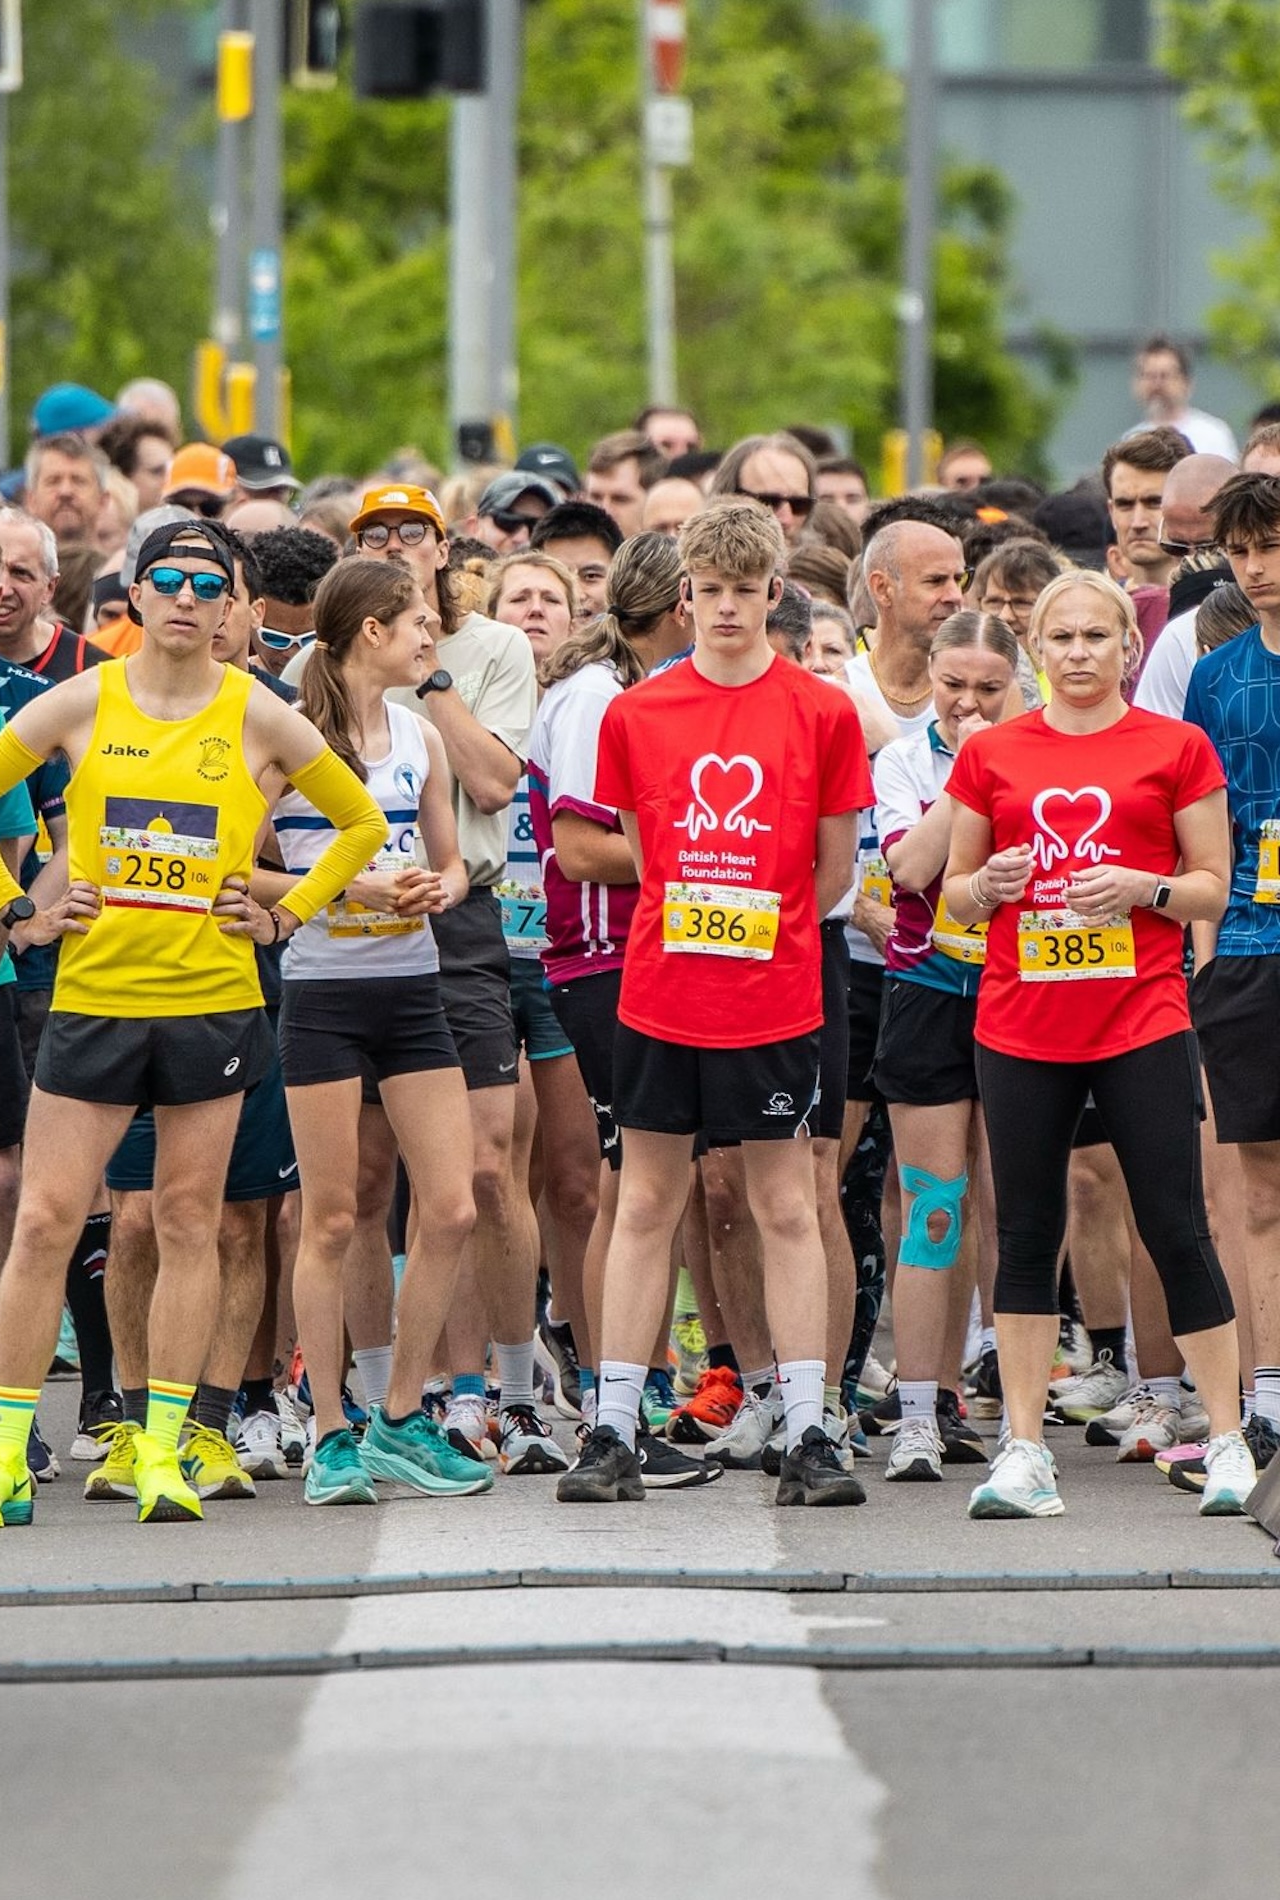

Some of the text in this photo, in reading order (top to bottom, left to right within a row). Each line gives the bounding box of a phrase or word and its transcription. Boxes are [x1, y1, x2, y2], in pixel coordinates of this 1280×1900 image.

[101, 743, 151, 758] Jake
[678, 850, 757, 867] British Heart
[124, 854, 210, 890] 258 10k
[682, 865, 753, 881] Foundation
[1033, 877, 1069, 892] British
[686, 908, 771, 943] 386 10k
[1043, 932, 1129, 967] 385 10k
